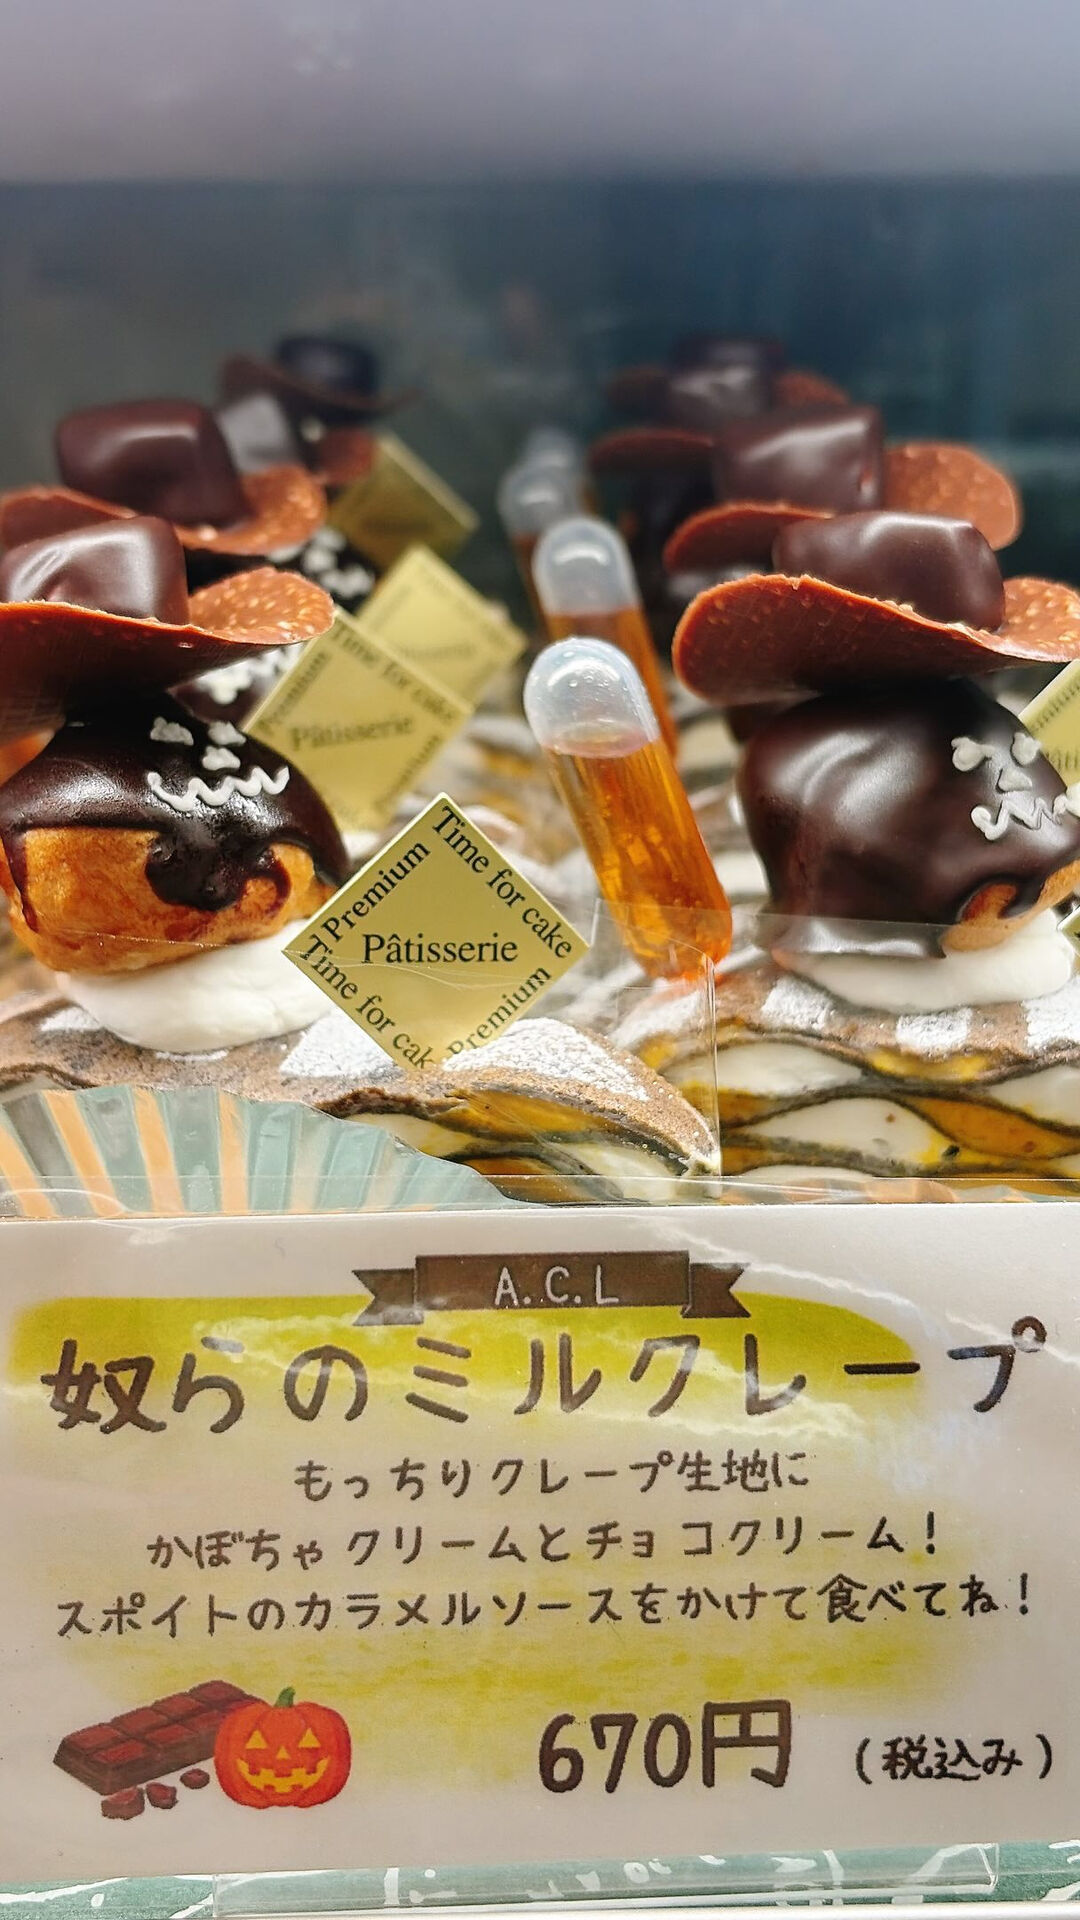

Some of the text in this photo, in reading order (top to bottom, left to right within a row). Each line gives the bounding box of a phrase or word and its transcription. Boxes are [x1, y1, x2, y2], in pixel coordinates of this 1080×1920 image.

[321, 842, 431, 942] Premium
[432, 805, 573, 959] Time for cake
[362, 932, 518, 964] Pâtisserie
[299, 933, 436, 1070] Time for cak
[447, 967, 552, 1055] Premium
[494, 1265, 620, 1306] A.C.L
[40, 1315, 1047, 1435] 奴らのミルクレープ
[294, 1449, 811, 1501] もっちりクレープ生地に
[147, 1511, 936, 1571] かぼちゃクリームとチョコクリーム!
[57, 1573, 1029, 1638] スポイトのカラメルソースをかけて食べてね!
[538, 1699, 1054, 1793] 670円 (税込み)
